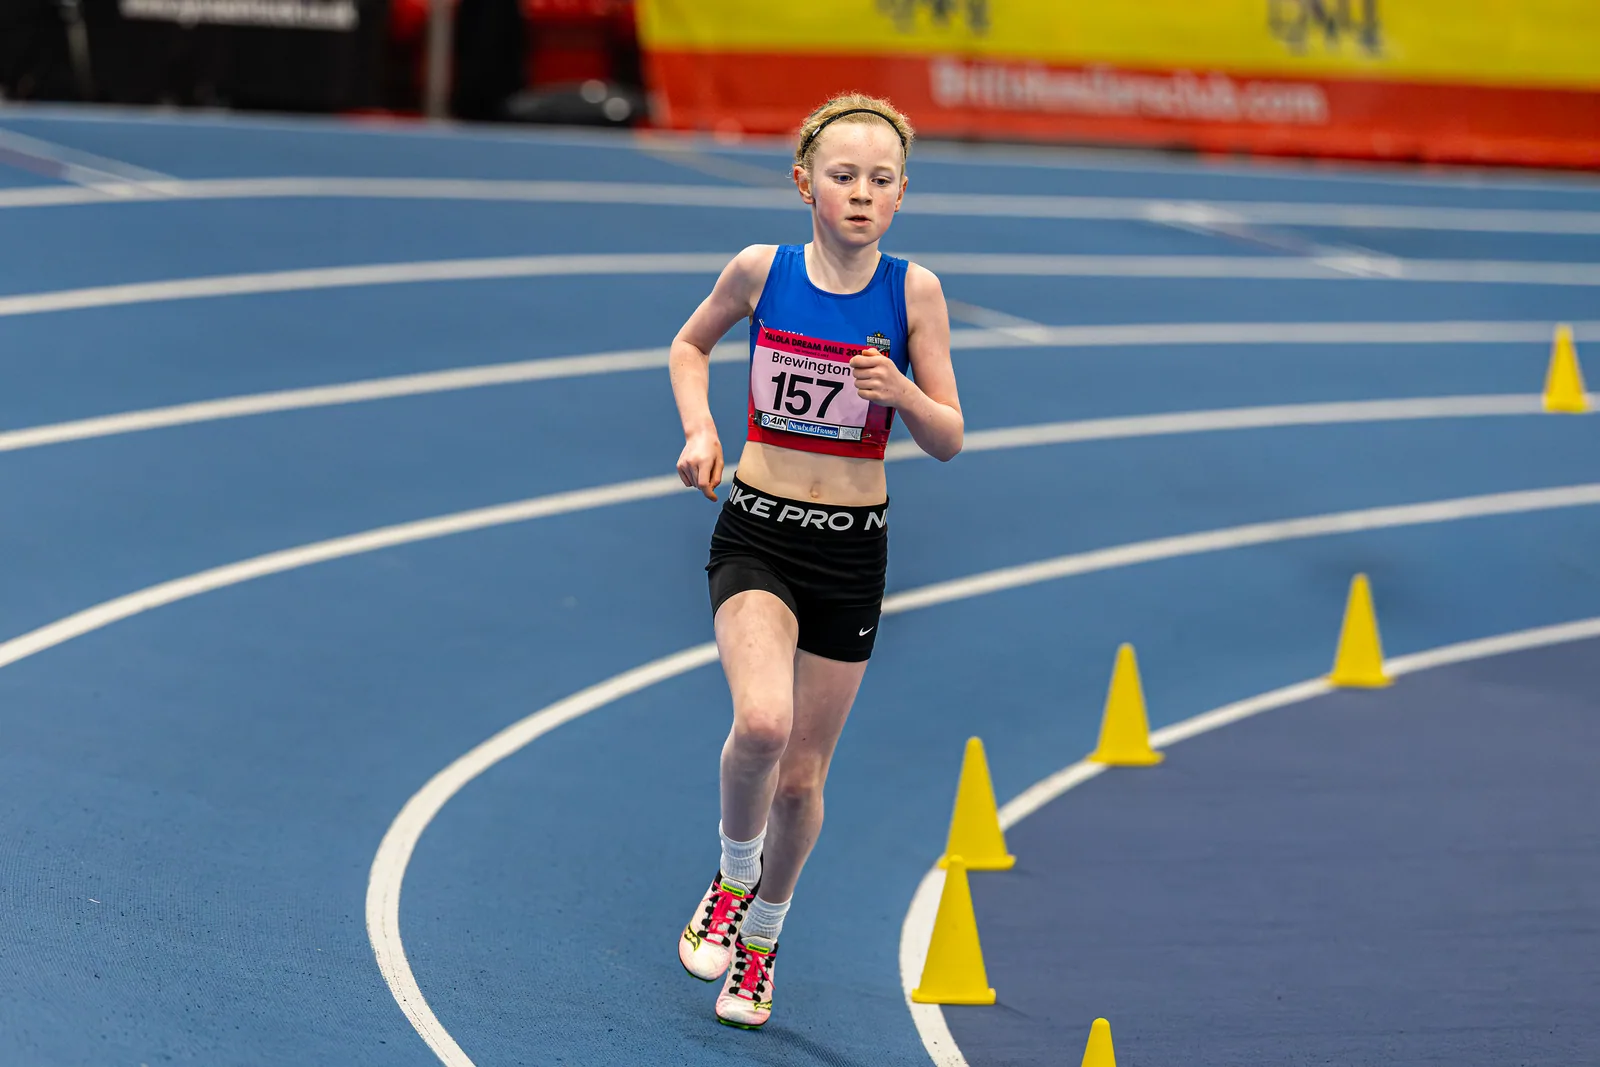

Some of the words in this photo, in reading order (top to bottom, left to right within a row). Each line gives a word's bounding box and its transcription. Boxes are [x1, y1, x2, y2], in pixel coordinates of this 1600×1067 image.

[792, 339, 821, 351] DREAM
[823, 345, 844, 355] MILE
[771, 351, 851, 376] Brewington
[771, 371, 844, 419] 157
[776, 504, 854, 531] PRO
